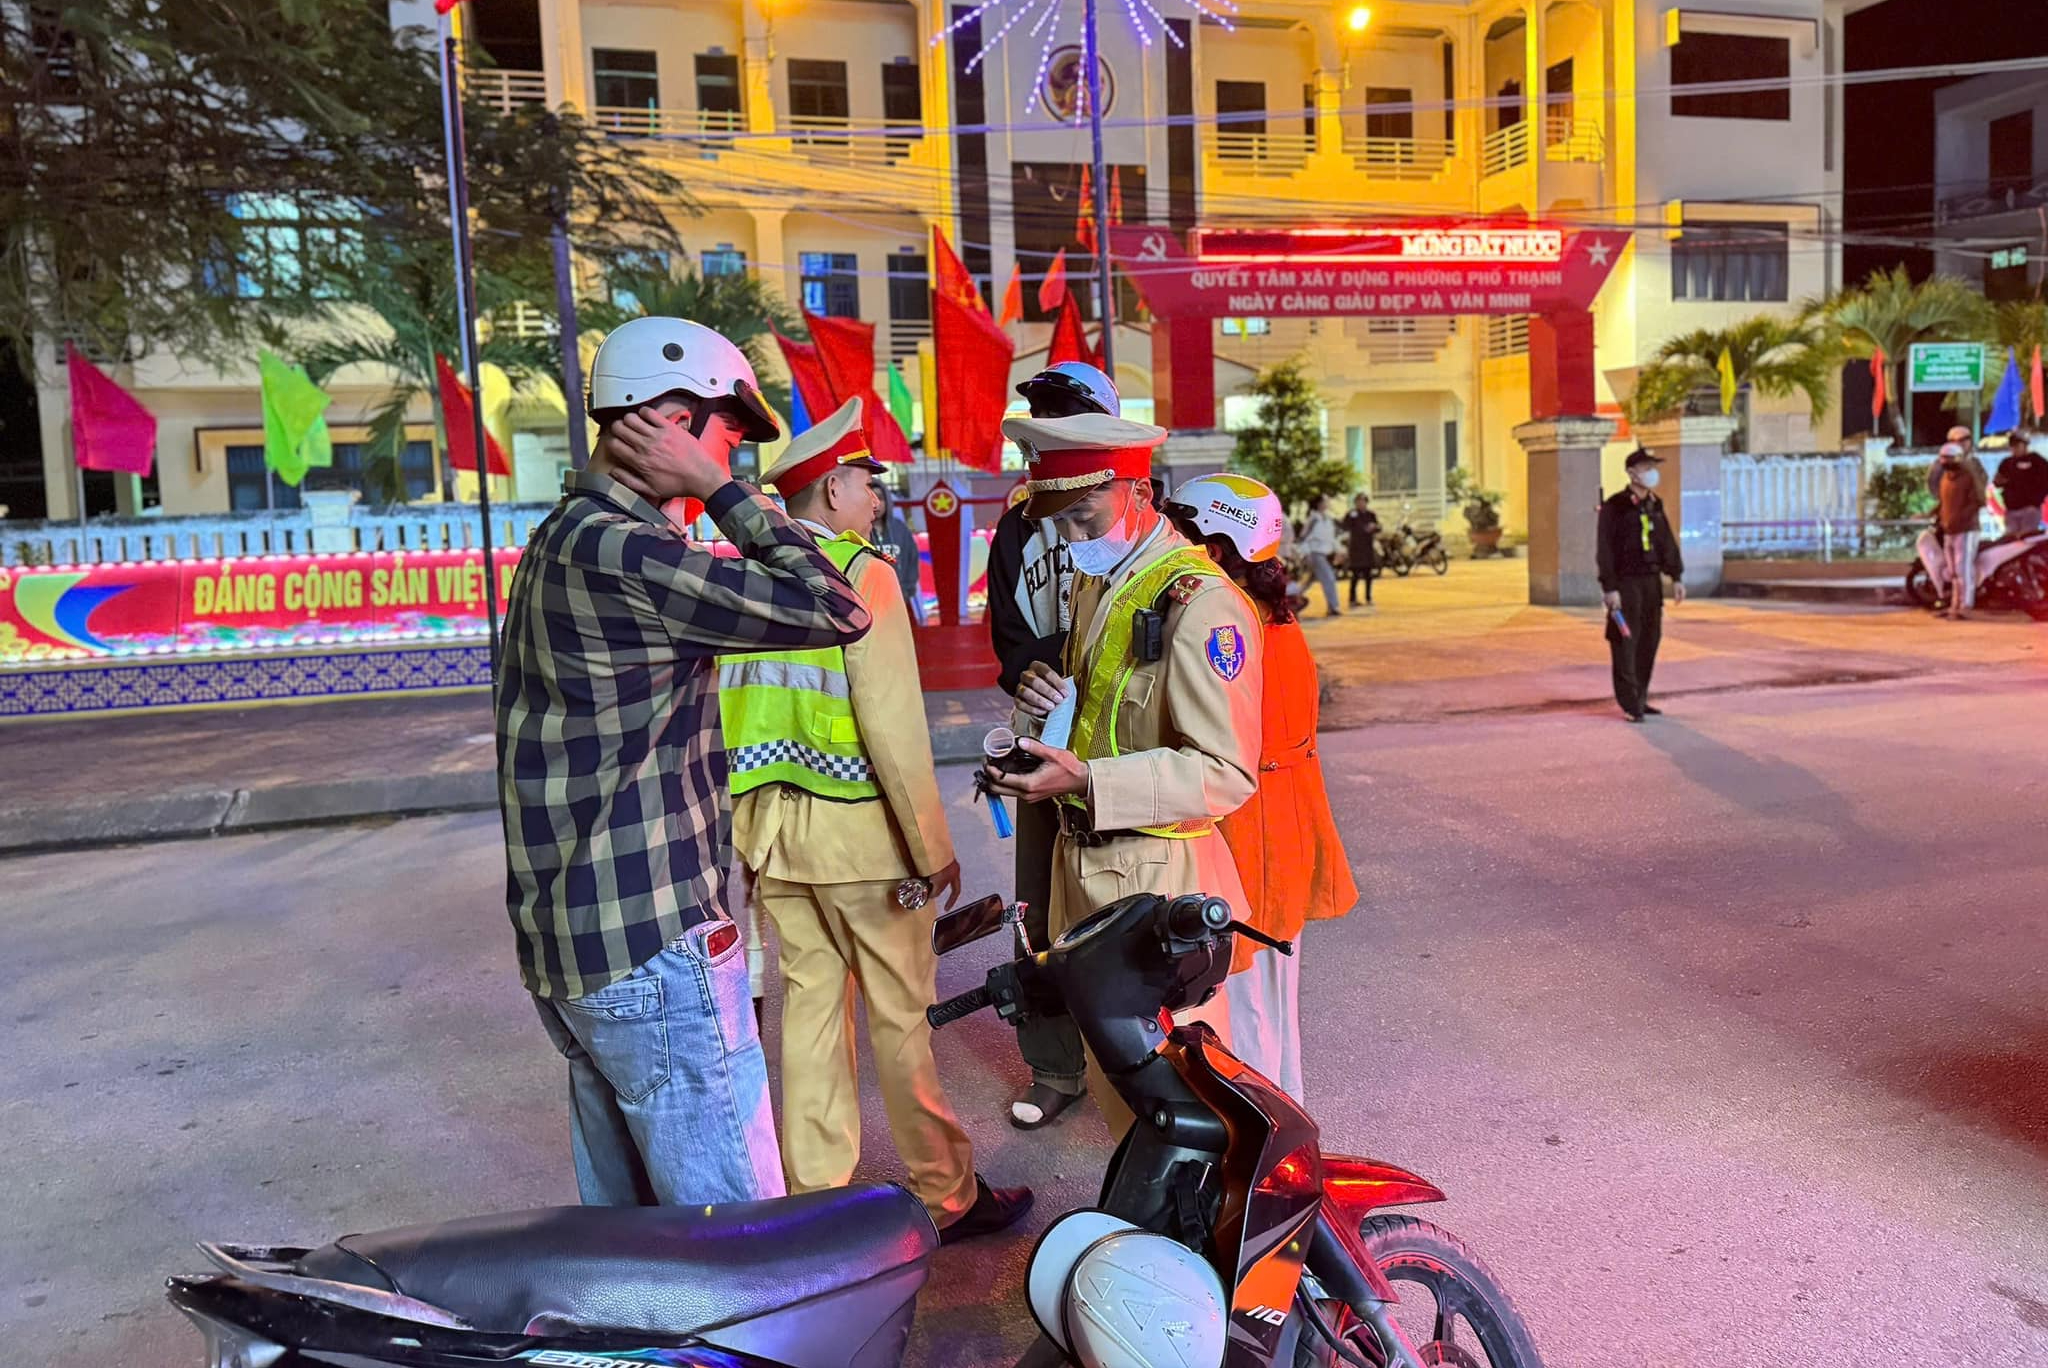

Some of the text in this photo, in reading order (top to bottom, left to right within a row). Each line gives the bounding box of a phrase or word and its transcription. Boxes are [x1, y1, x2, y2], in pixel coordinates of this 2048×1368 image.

[1191, 267, 1251, 288] QUYẾT
[1256, 268, 1296, 286] TÂM
[1301, 268, 1336, 286] XÂY
[1341, 270, 1389, 288] DỰNG
[1507, 271, 1562, 288] THẠNH
[1229, 290, 1531, 313] NGÀY CÀNG GIÀU ĐẸP VÀ VĂN MINH
[1219, 503, 1258, 526] ENEOS
[194, 562, 275, 615] ĐẢNG
[284, 564, 363, 617] CỘNG
[370, 555, 429, 605] SẢN
[1245, 1304, 1288, 1326] 110
